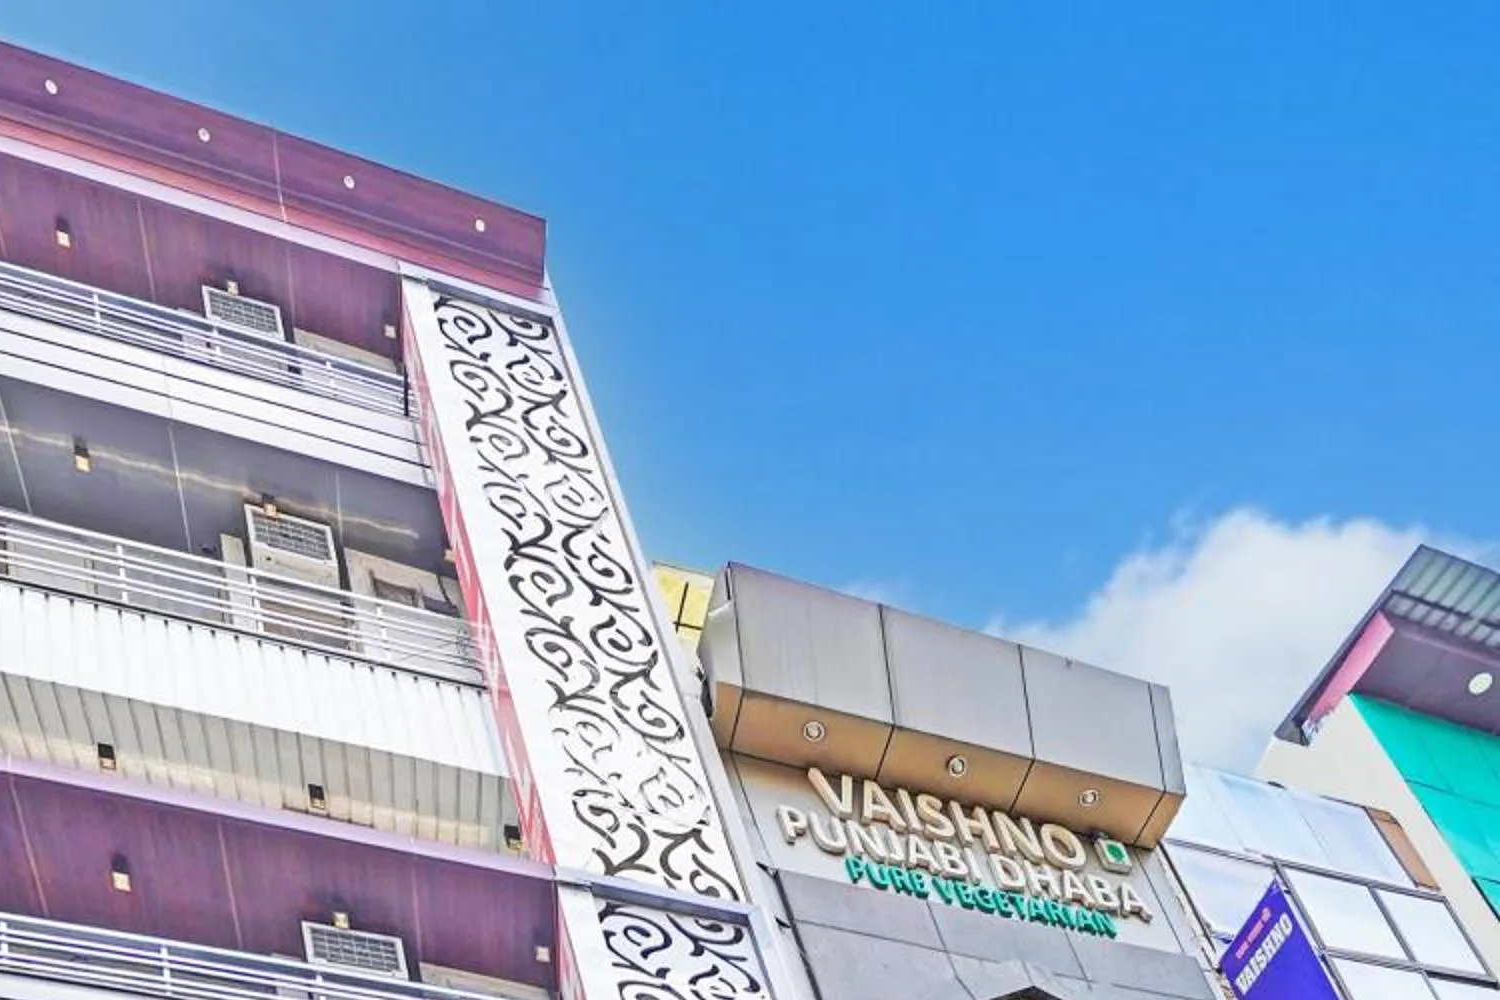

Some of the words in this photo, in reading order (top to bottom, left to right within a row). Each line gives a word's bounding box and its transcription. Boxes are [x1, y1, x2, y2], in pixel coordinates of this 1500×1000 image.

[776, 805, 983, 884] PUNJABI
[991, 854, 1153, 923] DHABA
[807, 768, 1087, 871] VAISHNO
[932, 876, 1118, 938] VEGETARIAN
[1235, 912, 1293, 996] VAISHNO
